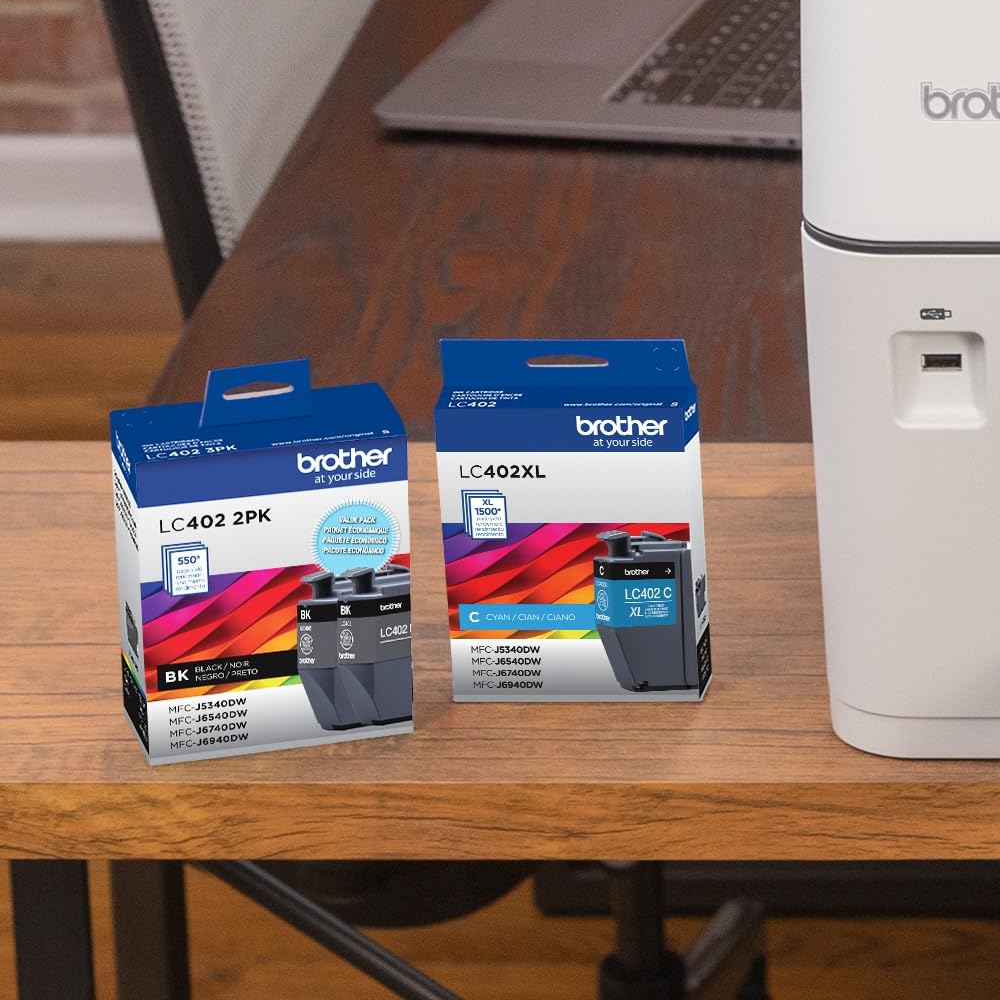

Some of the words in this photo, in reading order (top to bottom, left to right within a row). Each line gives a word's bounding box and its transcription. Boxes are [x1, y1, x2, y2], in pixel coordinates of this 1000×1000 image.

[575, 415, 668, 436] brother
[593, 438, 604, 447] at
[606, 439, 630, 449] your
[632, 438, 653, 447] side
[146, 448, 200, 460] LC402
[297, 447, 392, 474] brother
[314, 474, 326, 484] at
[328, 472, 352, 484] your
[354, 468, 376, 480] side
[460, 464, 546, 479] LC402XL
[482, 498, 494, 506] XL
[159, 512, 226, 534] LC402
[232, 508, 272, 526] 2PK
[359, 516, 376, 524] PACK
[599, 566, 604, 576] C
[624, 568, 650, 576] brother
[624, 588, 660, 600] LC402
[663, 586, 672, 599] C
[340, 604, 352, 616] BK
[380, 602, 402, 612] brother
[629, 606, 644, 618] XL
[300, 610, 312, 620] BK
[468, 612, 480, 623] C
[486, 613, 511, 622] CYAN
[518, 613, 540, 622] CIAN
[546, 613, 576, 622] CIANO
[380, 624, 408, 638] LC402
[470, 645, 540, 654] MFC-J5340DW
[338, 652, 356, 660] brother
[472, 657, 542, 666] MFC-J6540DW
[194, 664, 224, 674] BLACK
[472, 668, 542, 678] MFC-J6740DW
[165, 668, 190, 684] BK
[195, 672, 224, 682] NEGRO
[473, 680, 543, 689] MFC-J6940DW
[168, 697, 247, 714] MFC-J5340DW
[169, 709, 248, 726] MFC-J6540DW
[170, 721, 248, 738] MFC-J6740DW
[170, 732, 249, 750] MFC-J6940DW
